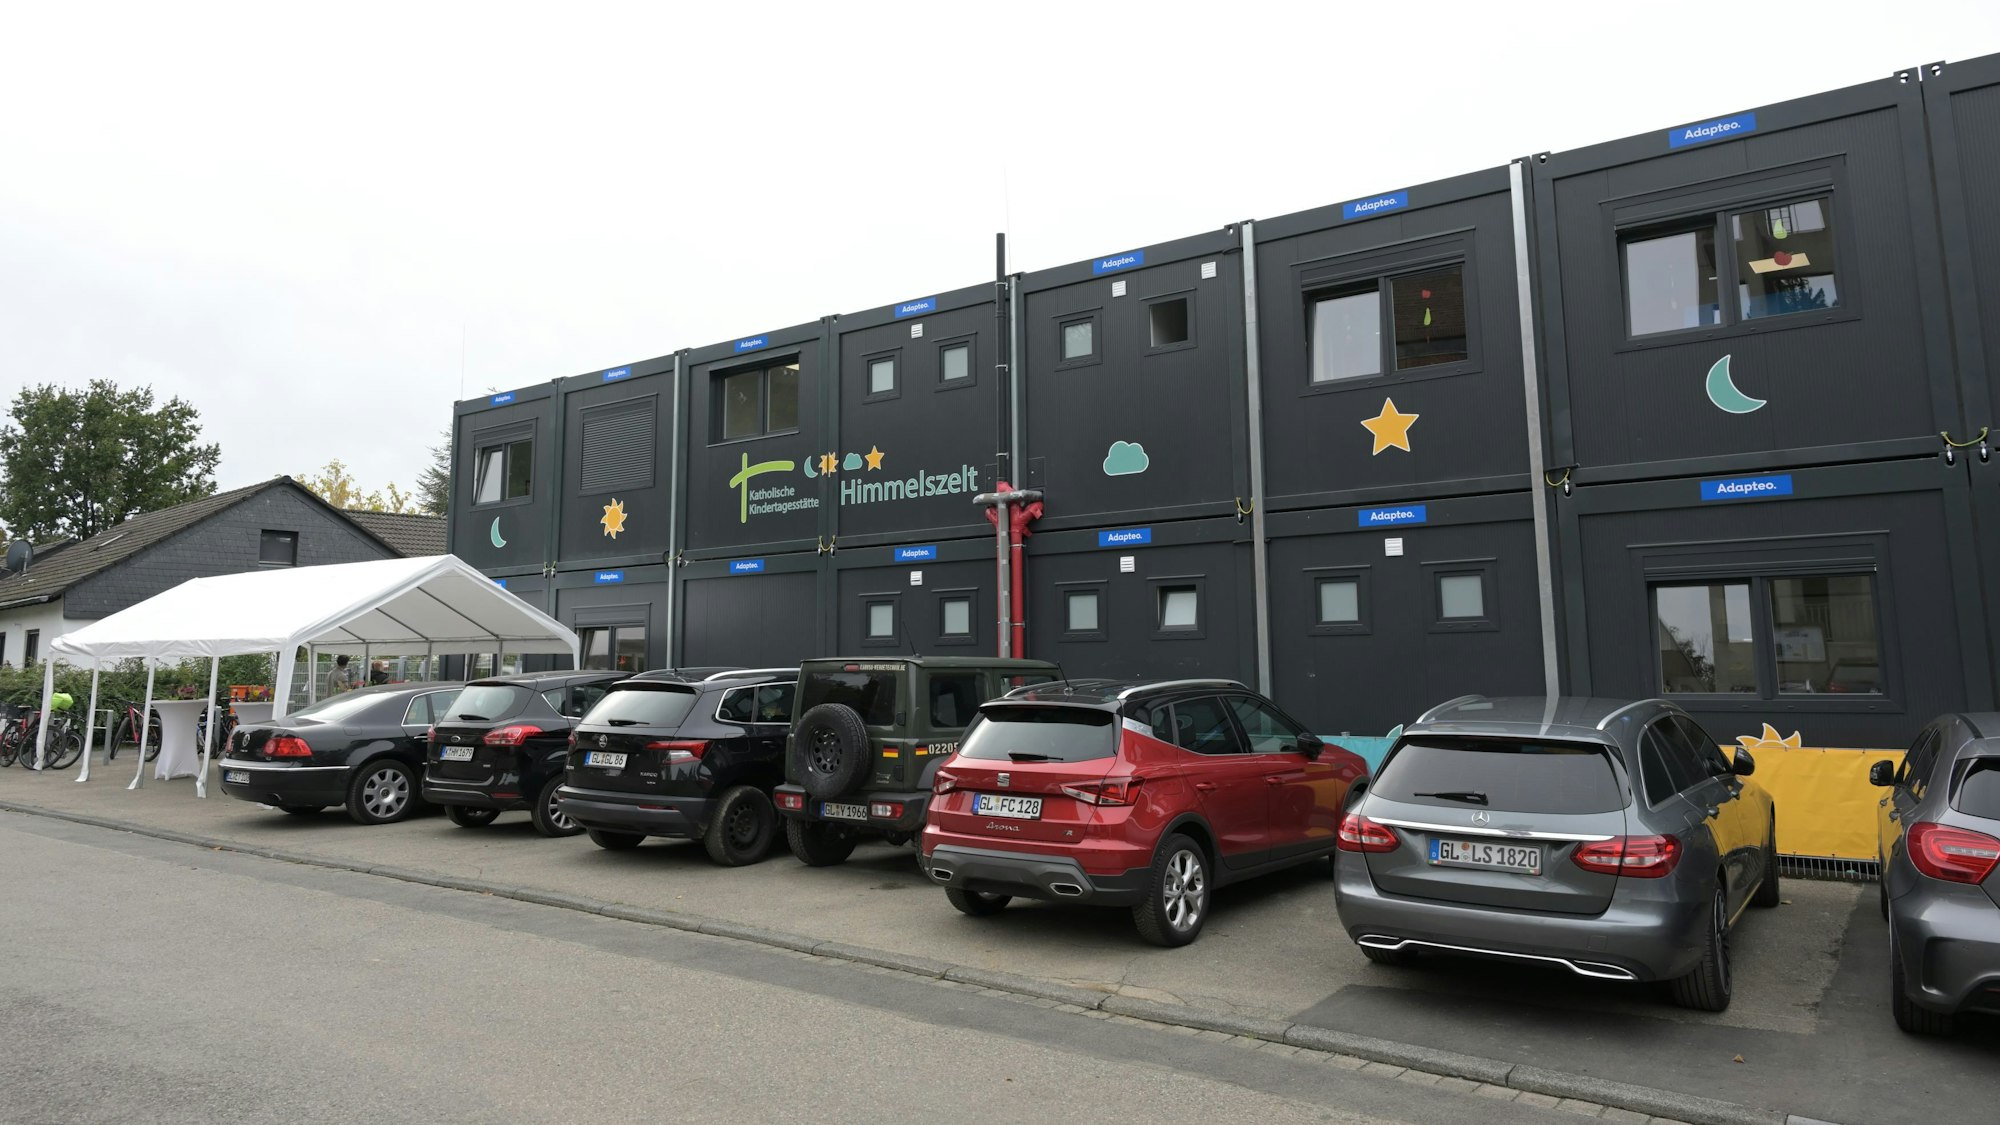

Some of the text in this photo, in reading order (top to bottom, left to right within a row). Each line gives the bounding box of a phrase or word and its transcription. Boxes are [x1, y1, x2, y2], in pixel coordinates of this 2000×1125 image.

[1684, 121, 1741, 140] Adapteo.
[1354, 198, 1398, 213] Adapteo.
[1102, 256, 1136, 269] Adapteo.
[901, 302, 930, 313] Adapteo.
[740, 339, 763, 349] Adapteo.
[840, 464, 979, 506] Himmelszelt
[1717, 481, 1777, 495] Adapteo.
[749, 485, 795, 501] Katholische
[749, 497, 819, 515] Kindertagesstätte
[1370, 510, 1415, 522] Adapteo.
[1107, 532, 1143, 543] Adapteo.
[901, 549, 930, 559] Adapteo.
[735, 562, 759, 571] Adapteo.
[591, 753, 624, 766] GL GL 86
[825, 803, 867, 819] GL Y 1966
[980, 796, 1040, 815] GL FC 128
[985, 821, 1020, 832] Arona
[1440, 842, 1460, 861] GL
[1471, 844, 1493, 864] LS
[1496, 847, 1538, 868] 1820
